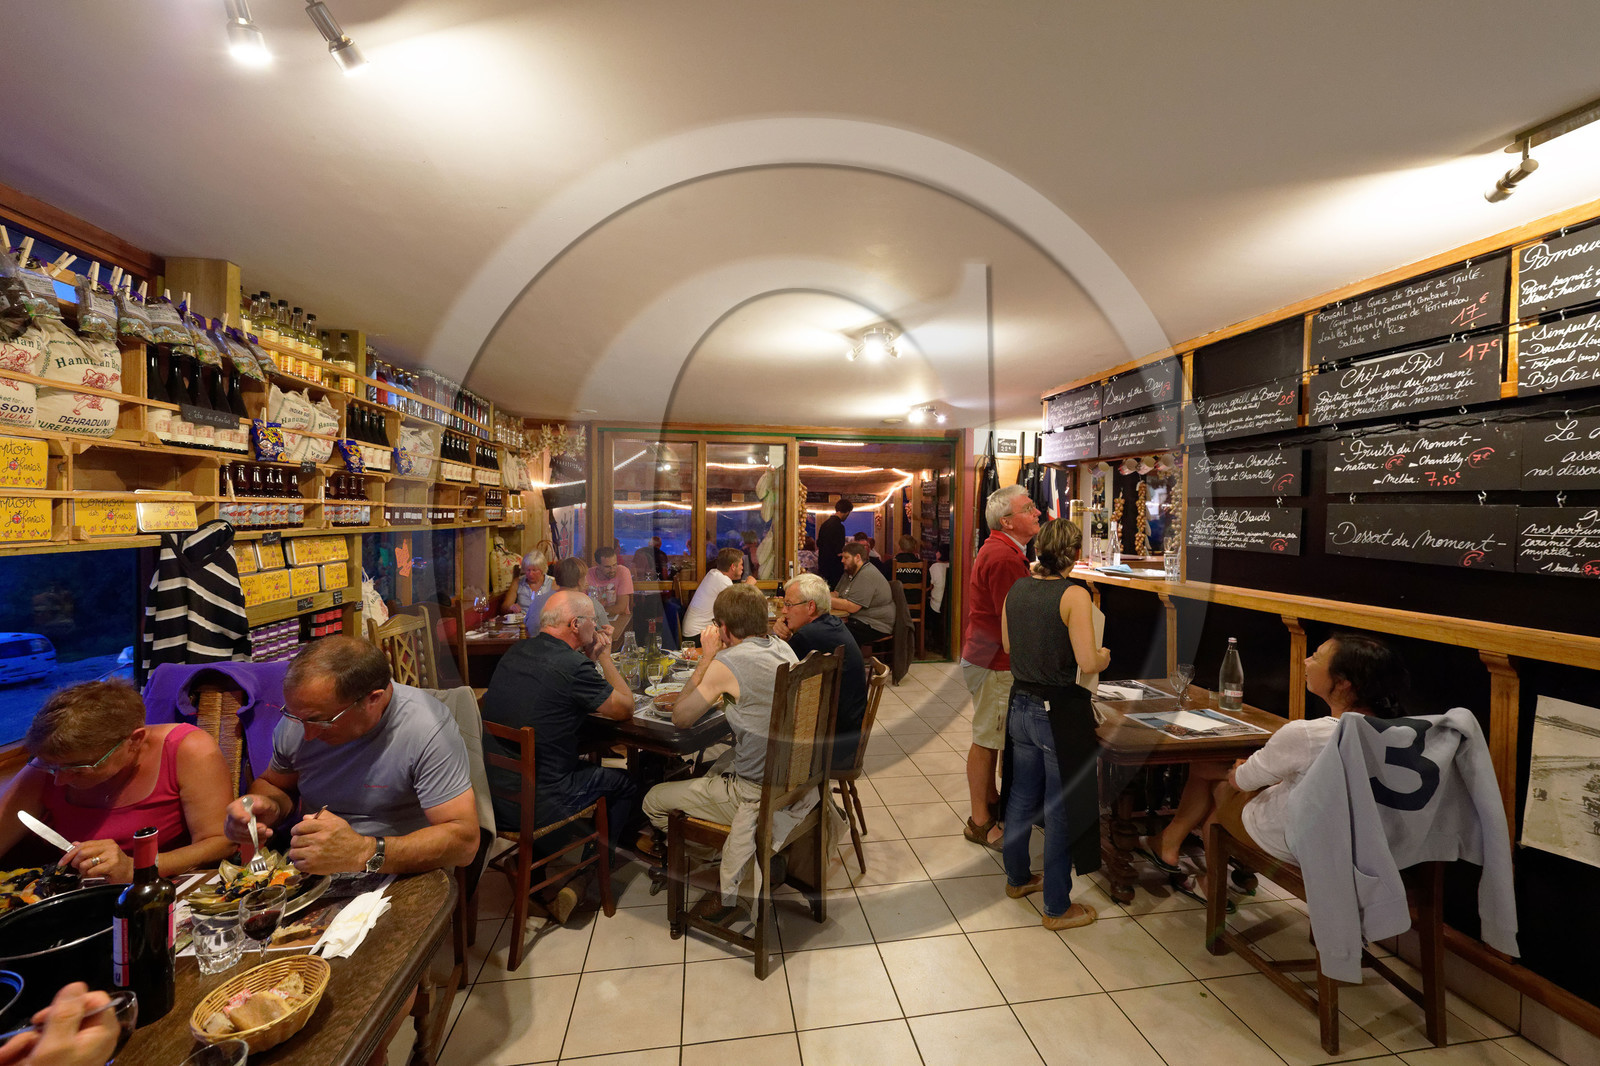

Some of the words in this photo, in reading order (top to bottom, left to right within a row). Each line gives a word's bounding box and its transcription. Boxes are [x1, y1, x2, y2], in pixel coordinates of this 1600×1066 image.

[0, 403, 34, 414] SONS
[38, 420, 62, 431] URE
[1363, 715, 1440, 811] 3
